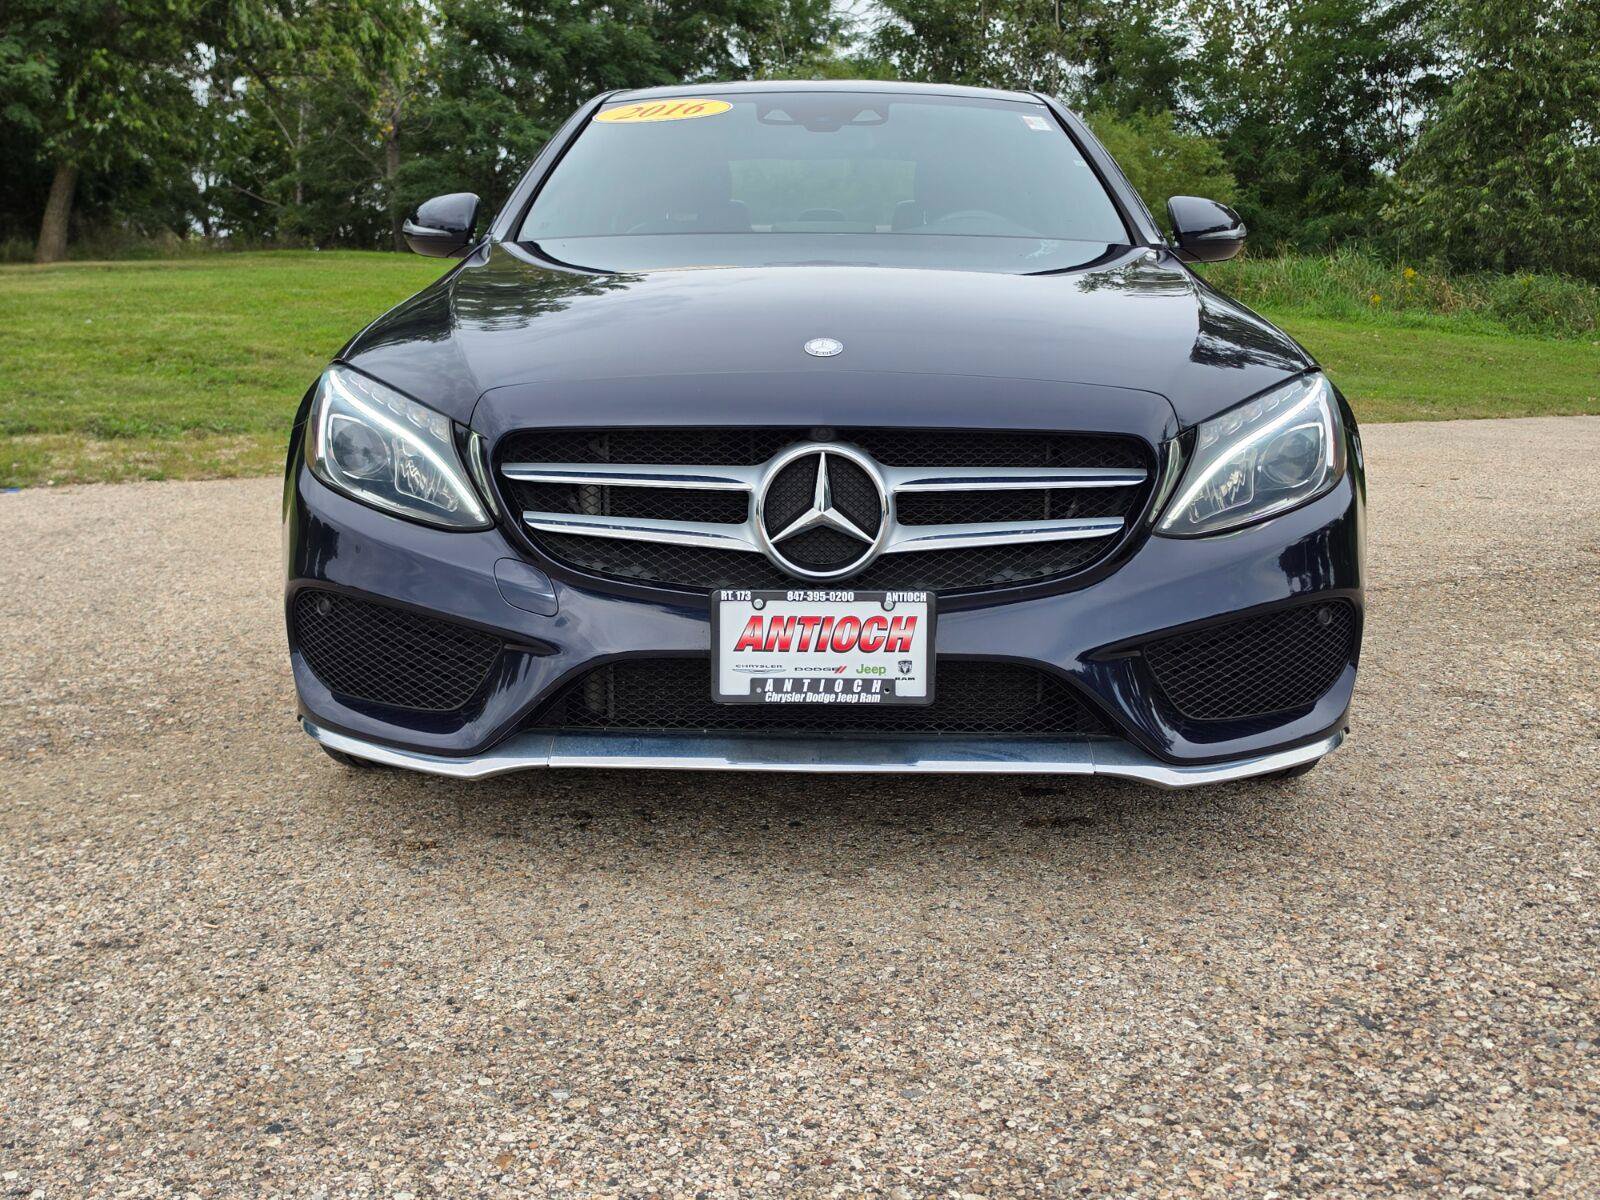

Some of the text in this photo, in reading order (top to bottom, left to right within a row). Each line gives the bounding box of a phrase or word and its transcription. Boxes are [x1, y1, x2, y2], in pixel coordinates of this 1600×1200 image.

[613, 101, 709, 121] 2016
[720, 590, 752, 601] RT. 173
[786, 591, 855, 602] 847-395-0200
[885, 591, 927, 602] ANTIOCH
[732, 615, 919, 654] ANTIOCH
[855, 663, 887, 676] Jeep
[764, 691, 881, 704] Chrysler Dodge Jeep Ram
